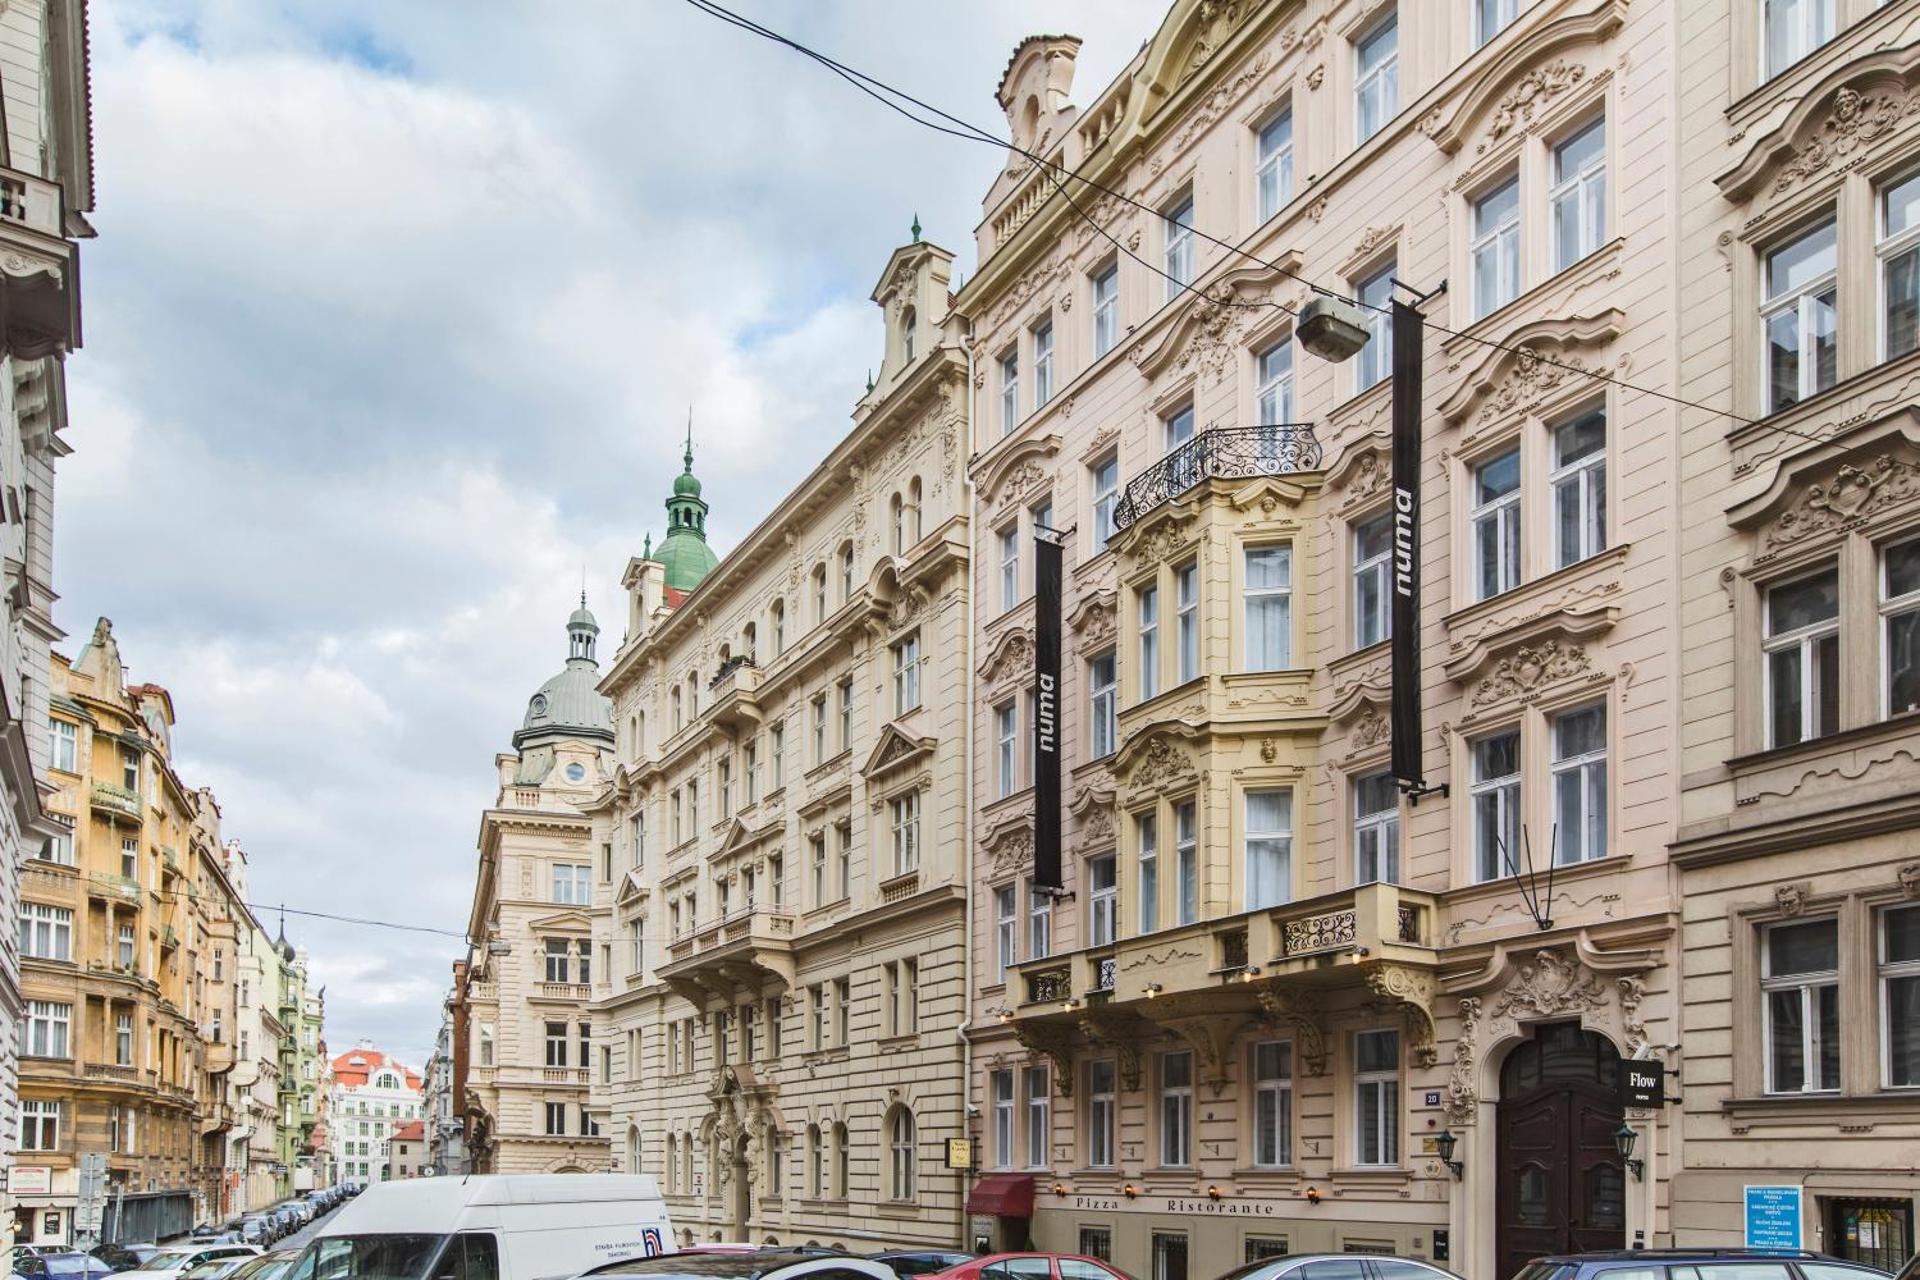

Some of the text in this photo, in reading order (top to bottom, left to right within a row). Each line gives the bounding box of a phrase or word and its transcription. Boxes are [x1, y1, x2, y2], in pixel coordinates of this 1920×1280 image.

[1396, 487, 1412, 597] numa
[1040, 673, 1054, 752] numa
[1629, 1072, 1656, 1088] Flow
[1427, 1095, 1437, 1103] 20
[1076, 1197, 1274, 1214] Pizza Ristorante
